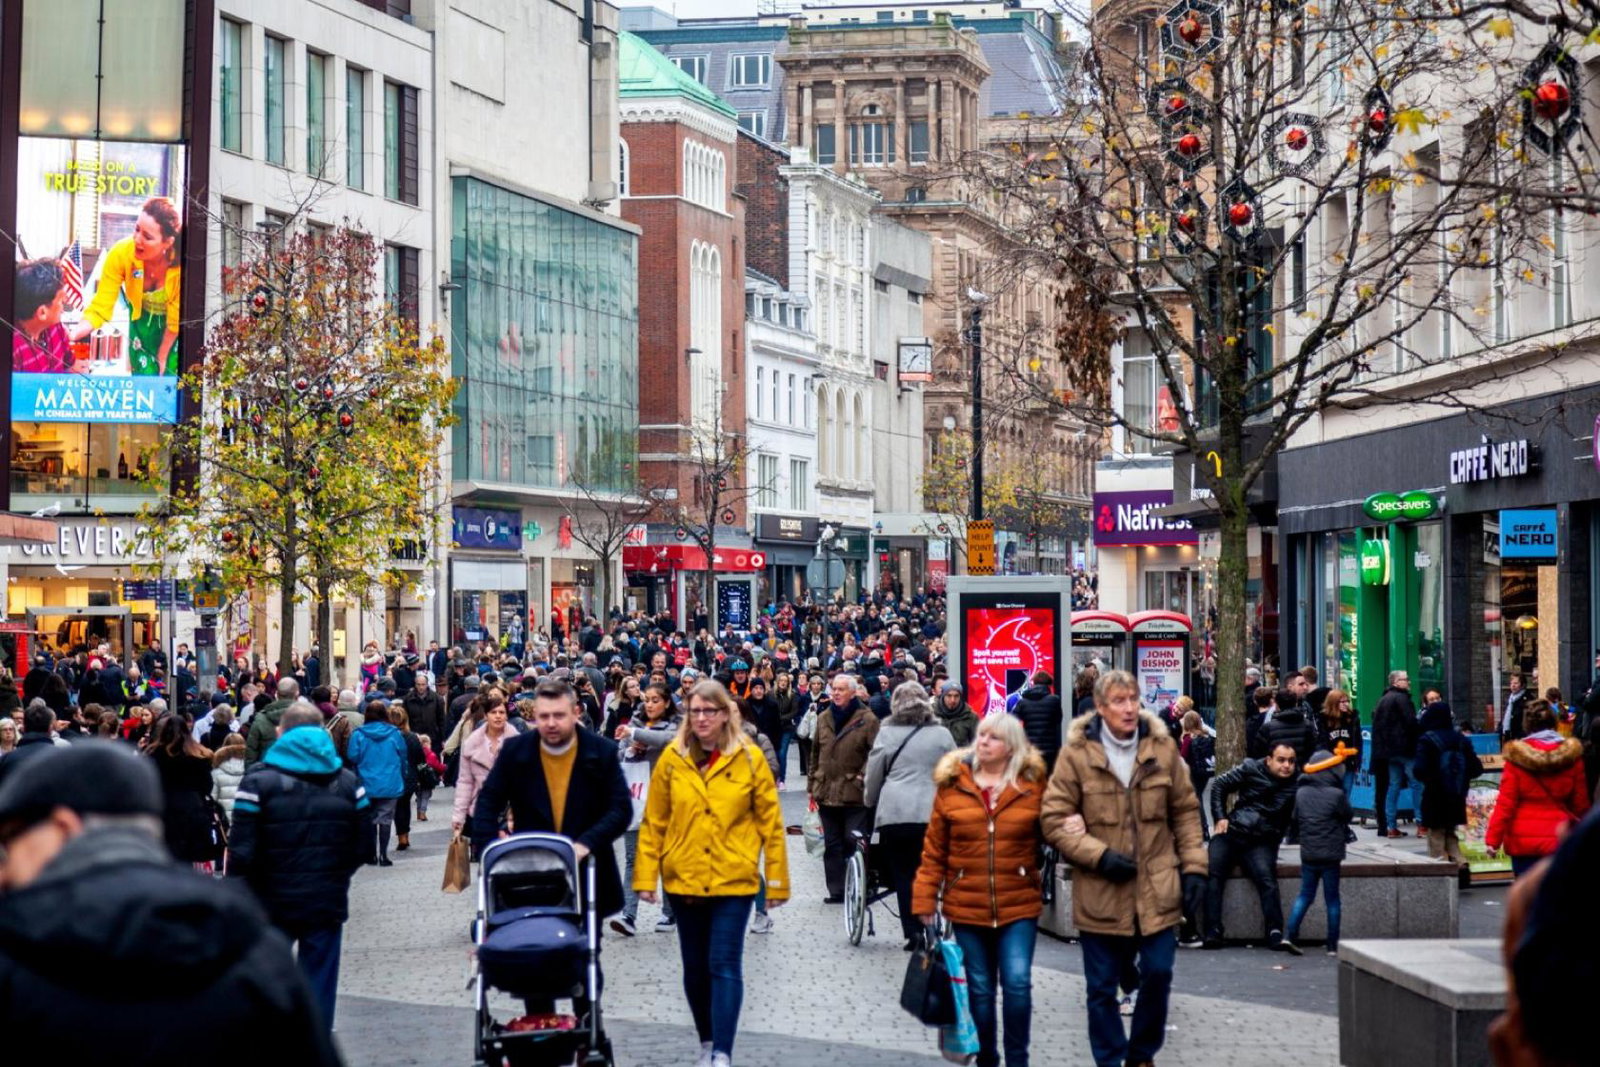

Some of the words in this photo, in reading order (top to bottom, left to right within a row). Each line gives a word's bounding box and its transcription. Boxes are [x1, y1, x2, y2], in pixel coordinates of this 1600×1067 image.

[106, 160, 124, 172] ON
[128, 161, 136, 173] A
[44, 172, 88, 193] TRUE
[96, 174, 158, 196] STORY
[56, 379, 113, 389] WELCOME
[120, 380, 134, 389] TO
[34, 388, 155, 410] MARWEN
[34, 409, 44, 417] IN
[46, 410, 82, 418] CINEMAS
[85, 410, 104, 418] NEW
[1491, 439, 1528, 479] NERO
[1371, 499, 1431, 514] Specsavers
[7, 526, 123, 555] EVER
[971, 533, 991, 541] HELP
[1505, 533, 1555, 545] NERO
[1146, 650, 1175, 658] JOHN
[1141, 659, 1180, 667] BISHOP
